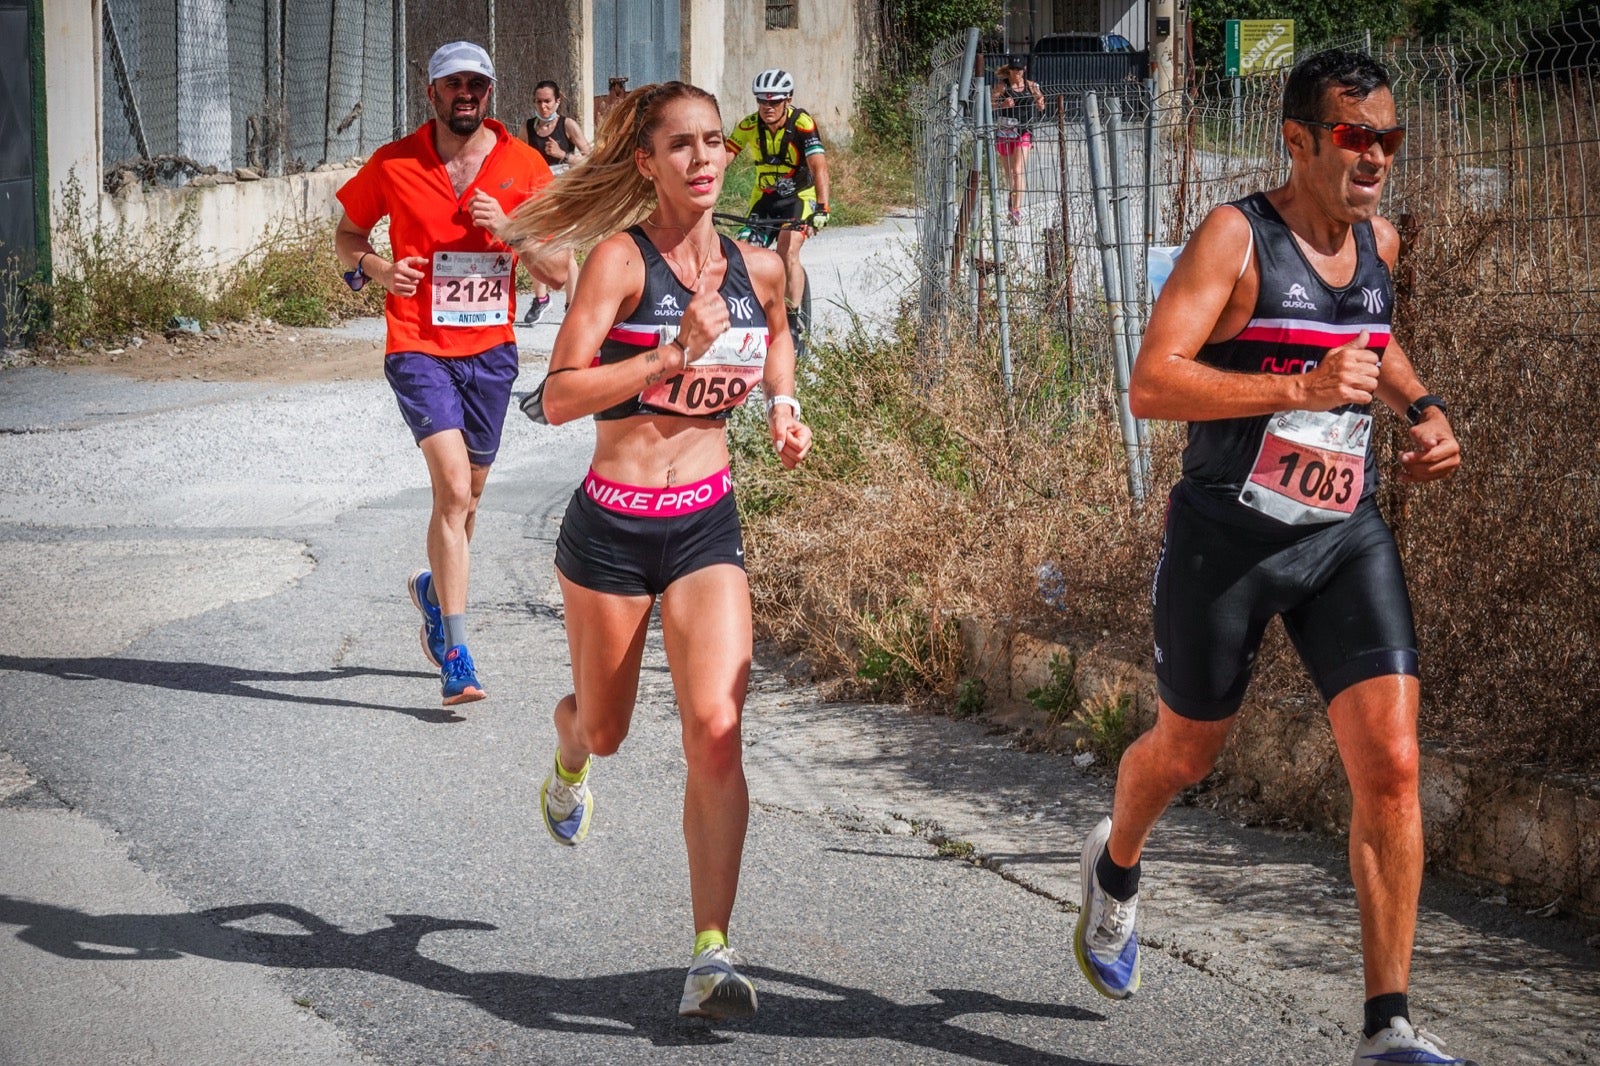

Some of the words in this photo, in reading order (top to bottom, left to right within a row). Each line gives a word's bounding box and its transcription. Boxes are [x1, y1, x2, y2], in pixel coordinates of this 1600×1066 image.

[1241, 23, 1285, 68] OBRAS
[446, 280, 502, 302] 2124
[458, 313, 487, 323] ANTONIO
[654, 309, 685, 317] austra
[664, 373, 747, 410] 1059
[1279, 451, 1354, 505] 1083
[586, 479, 653, 510] NIKE
[654, 484, 713, 511] PRO
